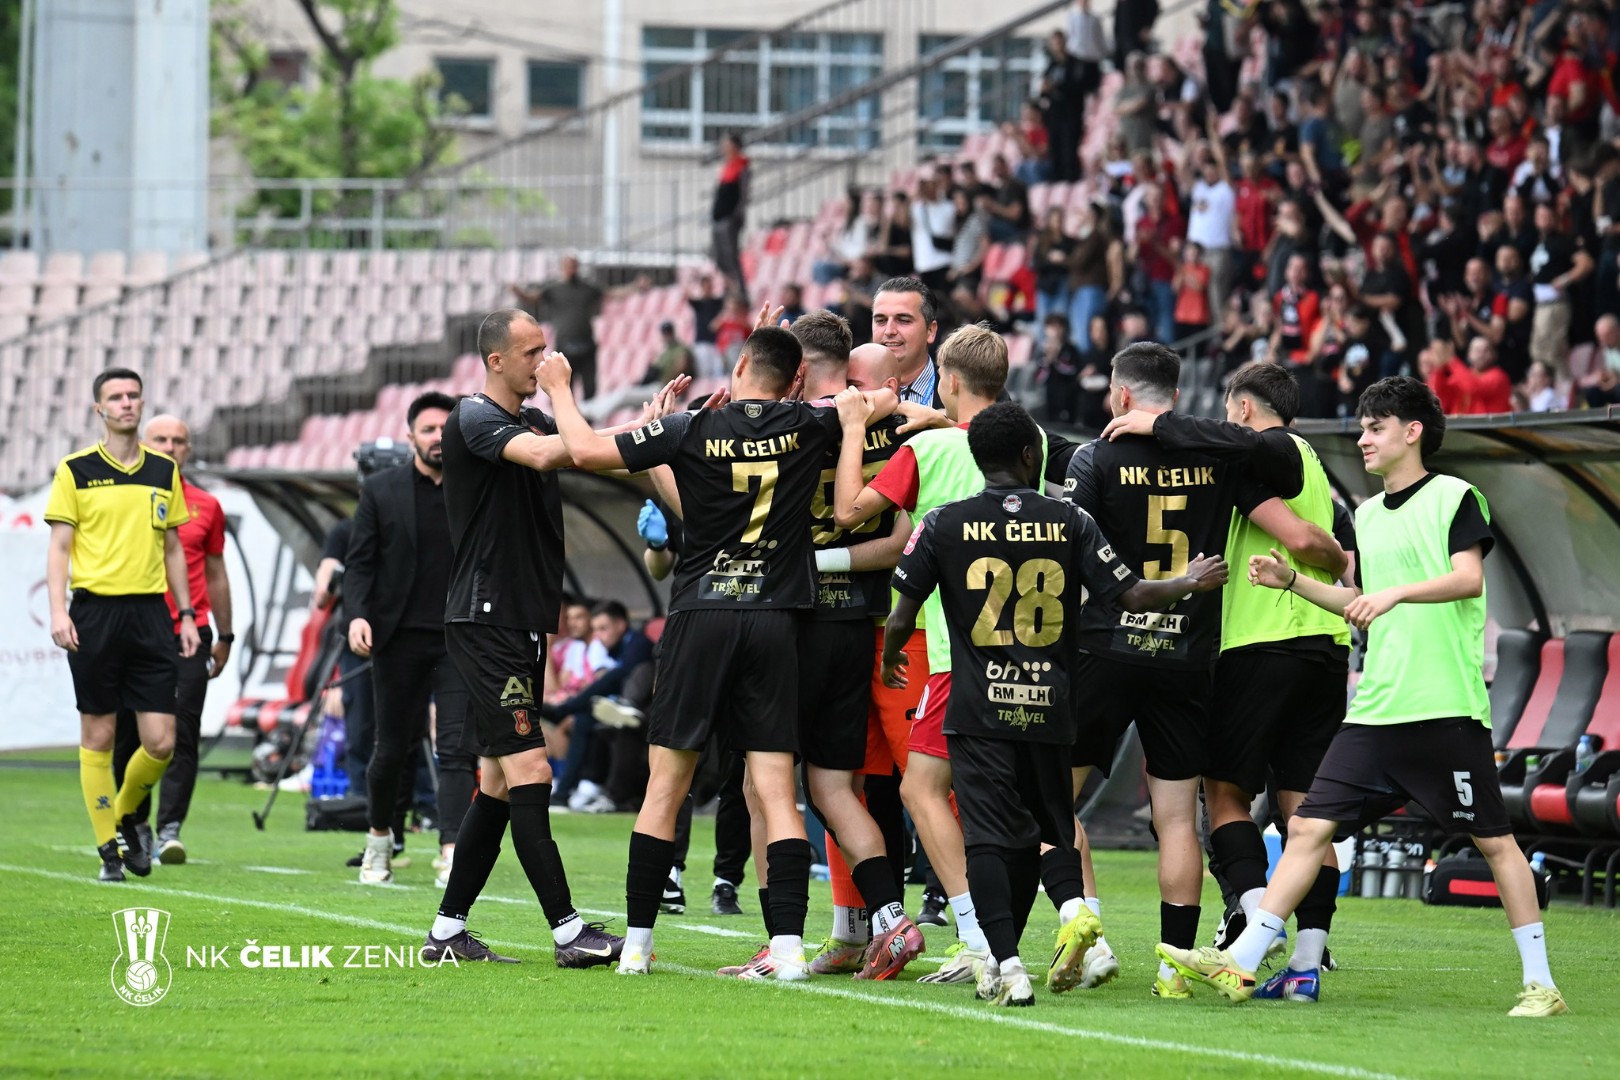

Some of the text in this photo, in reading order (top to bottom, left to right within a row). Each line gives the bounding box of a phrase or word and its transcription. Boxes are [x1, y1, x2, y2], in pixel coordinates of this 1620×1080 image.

[706, 432, 800, 457] NK ČELIK
[863, 428, 893, 451] LIK
[1120, 465, 1216, 489] NK ČELIK
[731, 460, 779, 544] 7
[963, 519, 1068, 542] NK ČELIK
[1143, 494, 1190, 581] 5
[711, 577, 761, 594] TRAVEL
[966, 556, 1065, 648] 28
[1127, 632, 1175, 650] TRAVEL
[993, 686, 1015, 700] RM
[1028, 688, 1046, 702] LH
[997, 706, 1046, 724] TRAVEL
[1453, 771, 1474, 807] 5
